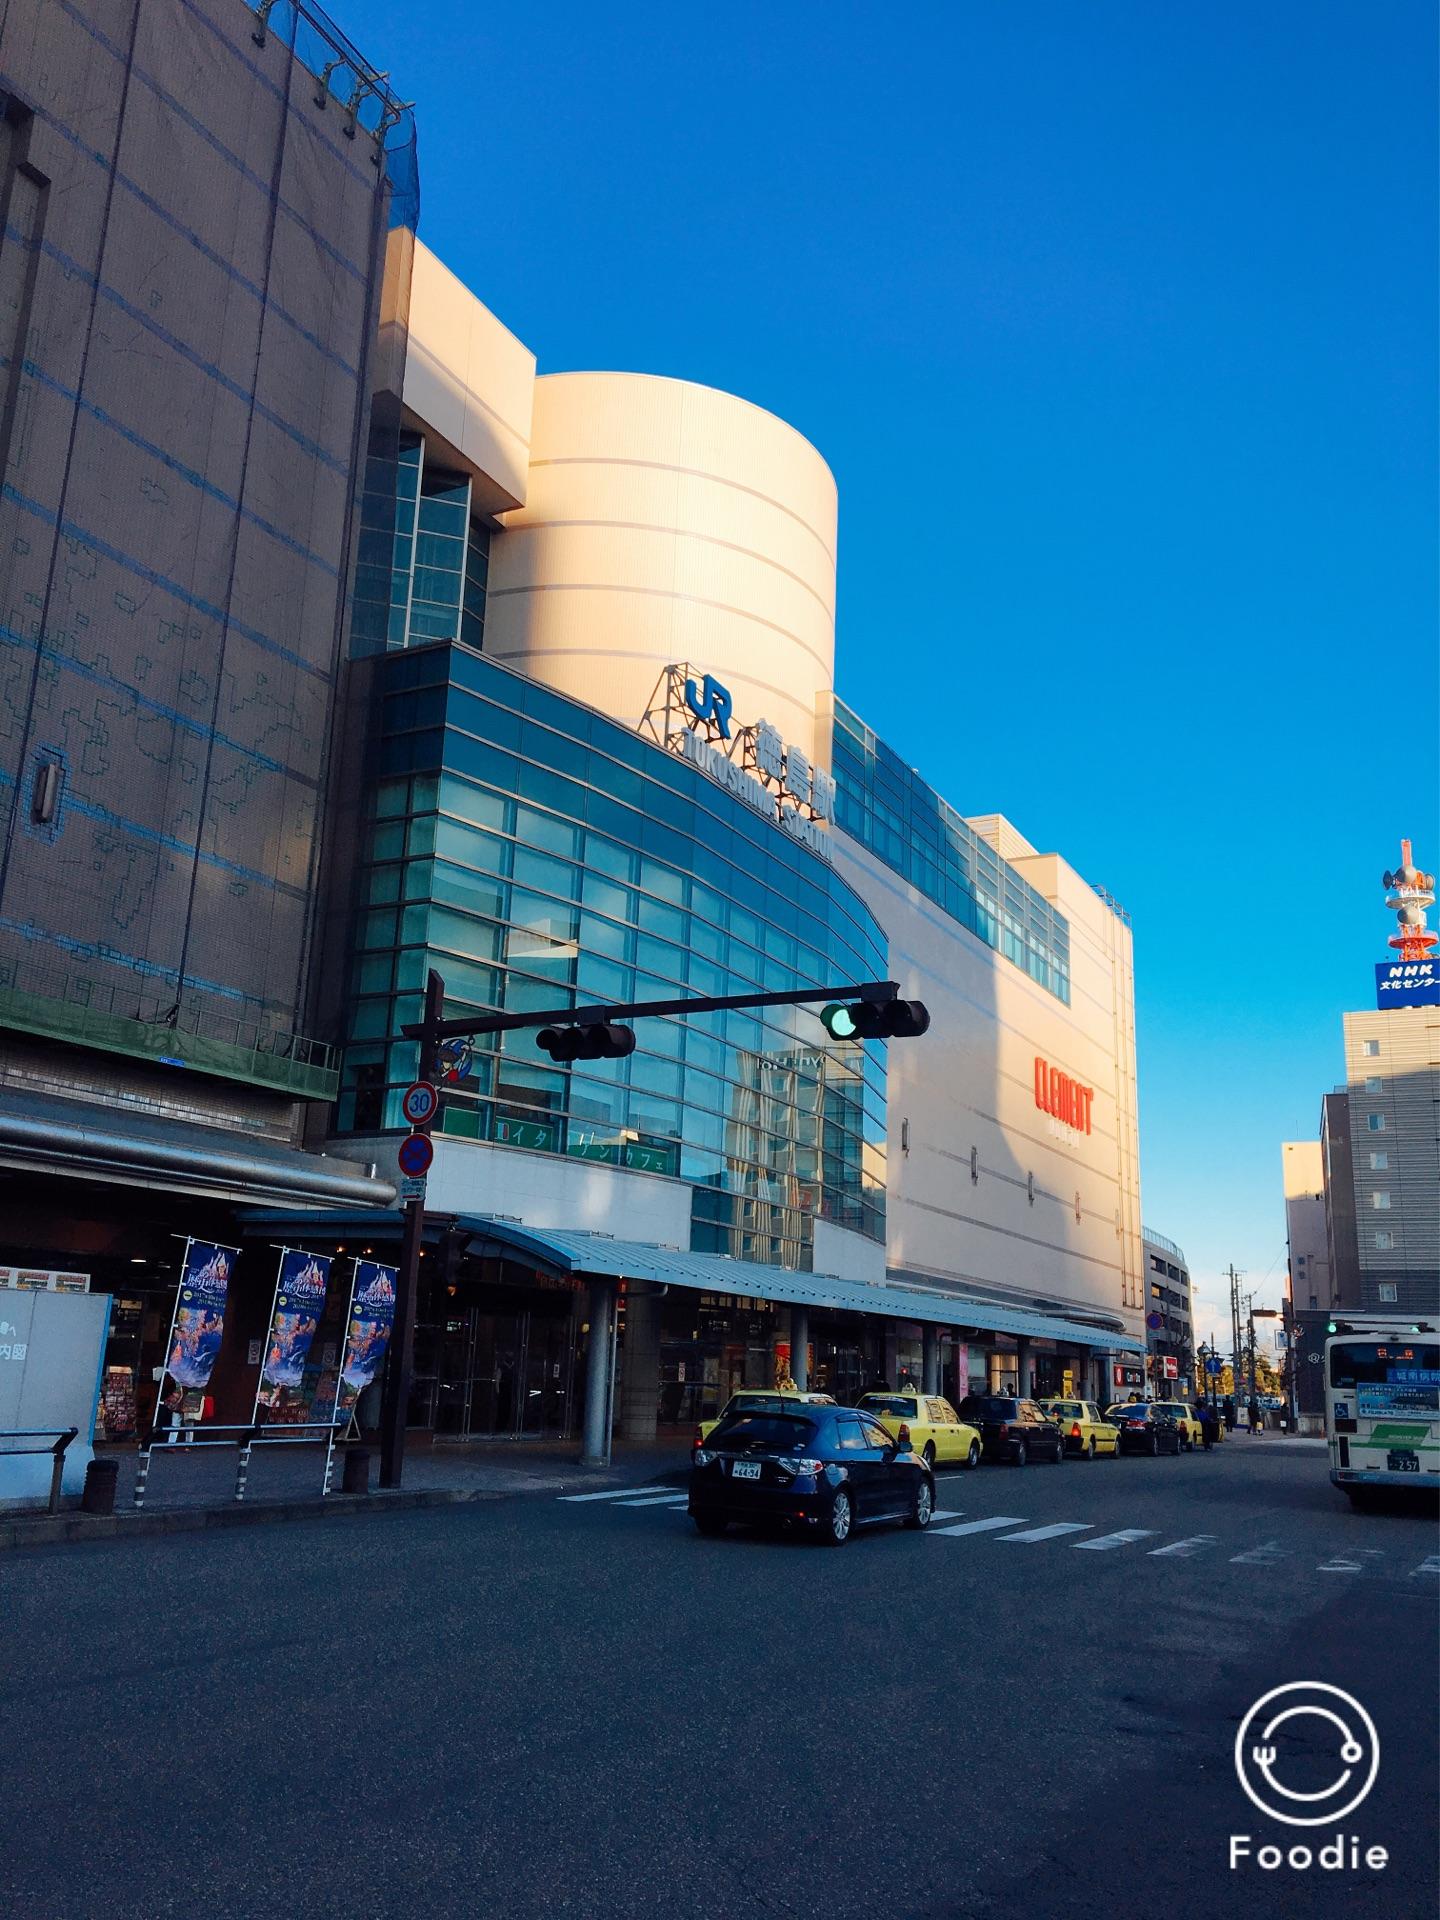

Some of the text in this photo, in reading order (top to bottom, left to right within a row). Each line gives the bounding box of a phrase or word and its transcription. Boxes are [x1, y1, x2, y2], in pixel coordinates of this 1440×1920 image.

[685, 674, 733, 740] JR
[681, 727, 834, 863] TOKUSHIMA STATION
[755, 718, 836, 826] 徳島駅
[1379, 978, 1440, 990] 文化センター
[1389, 964, 1433, 978] NHK
[409, 1093, 430, 1113] 30
[1034, 1056, 1094, 1136] CLEMENT
